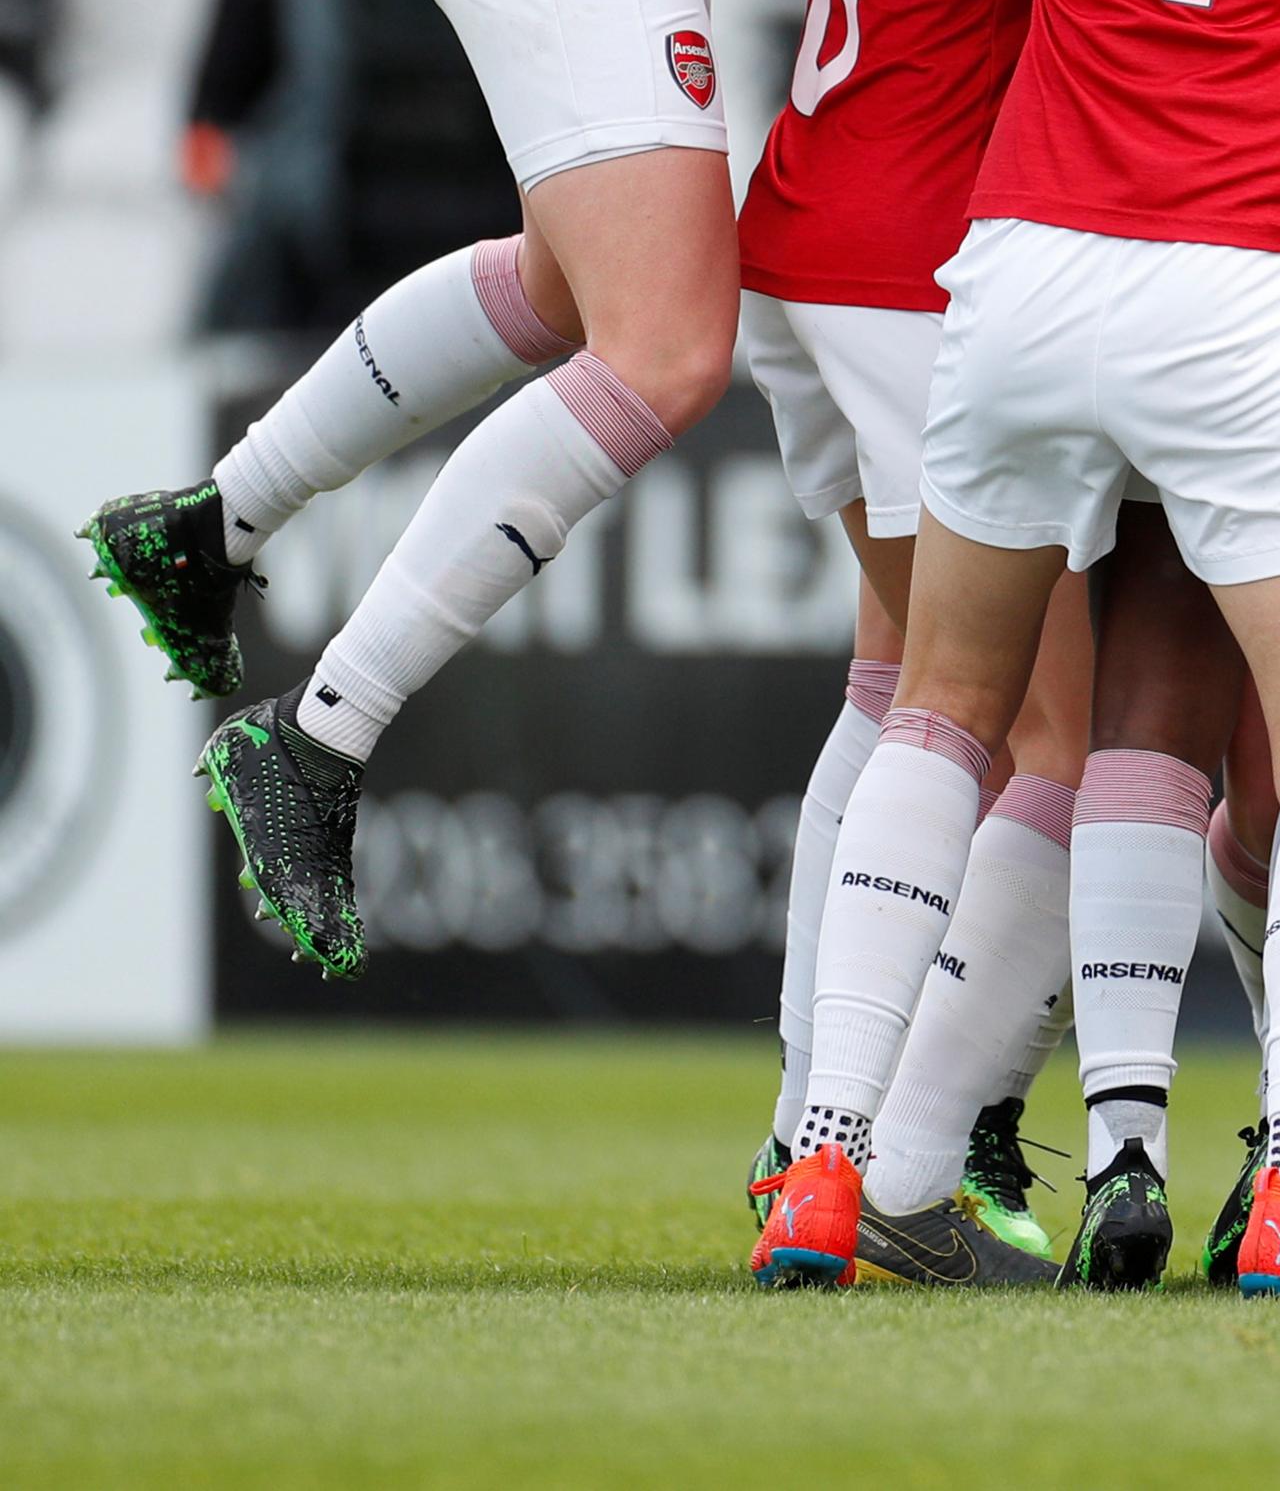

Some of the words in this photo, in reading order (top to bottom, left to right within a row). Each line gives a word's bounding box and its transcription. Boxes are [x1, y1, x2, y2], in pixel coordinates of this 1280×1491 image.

[355, 315, 400, 407] RSENAL
[841, 871, 951, 917] ARSENAL
[1081, 962, 1184, 984] ARSENAL
